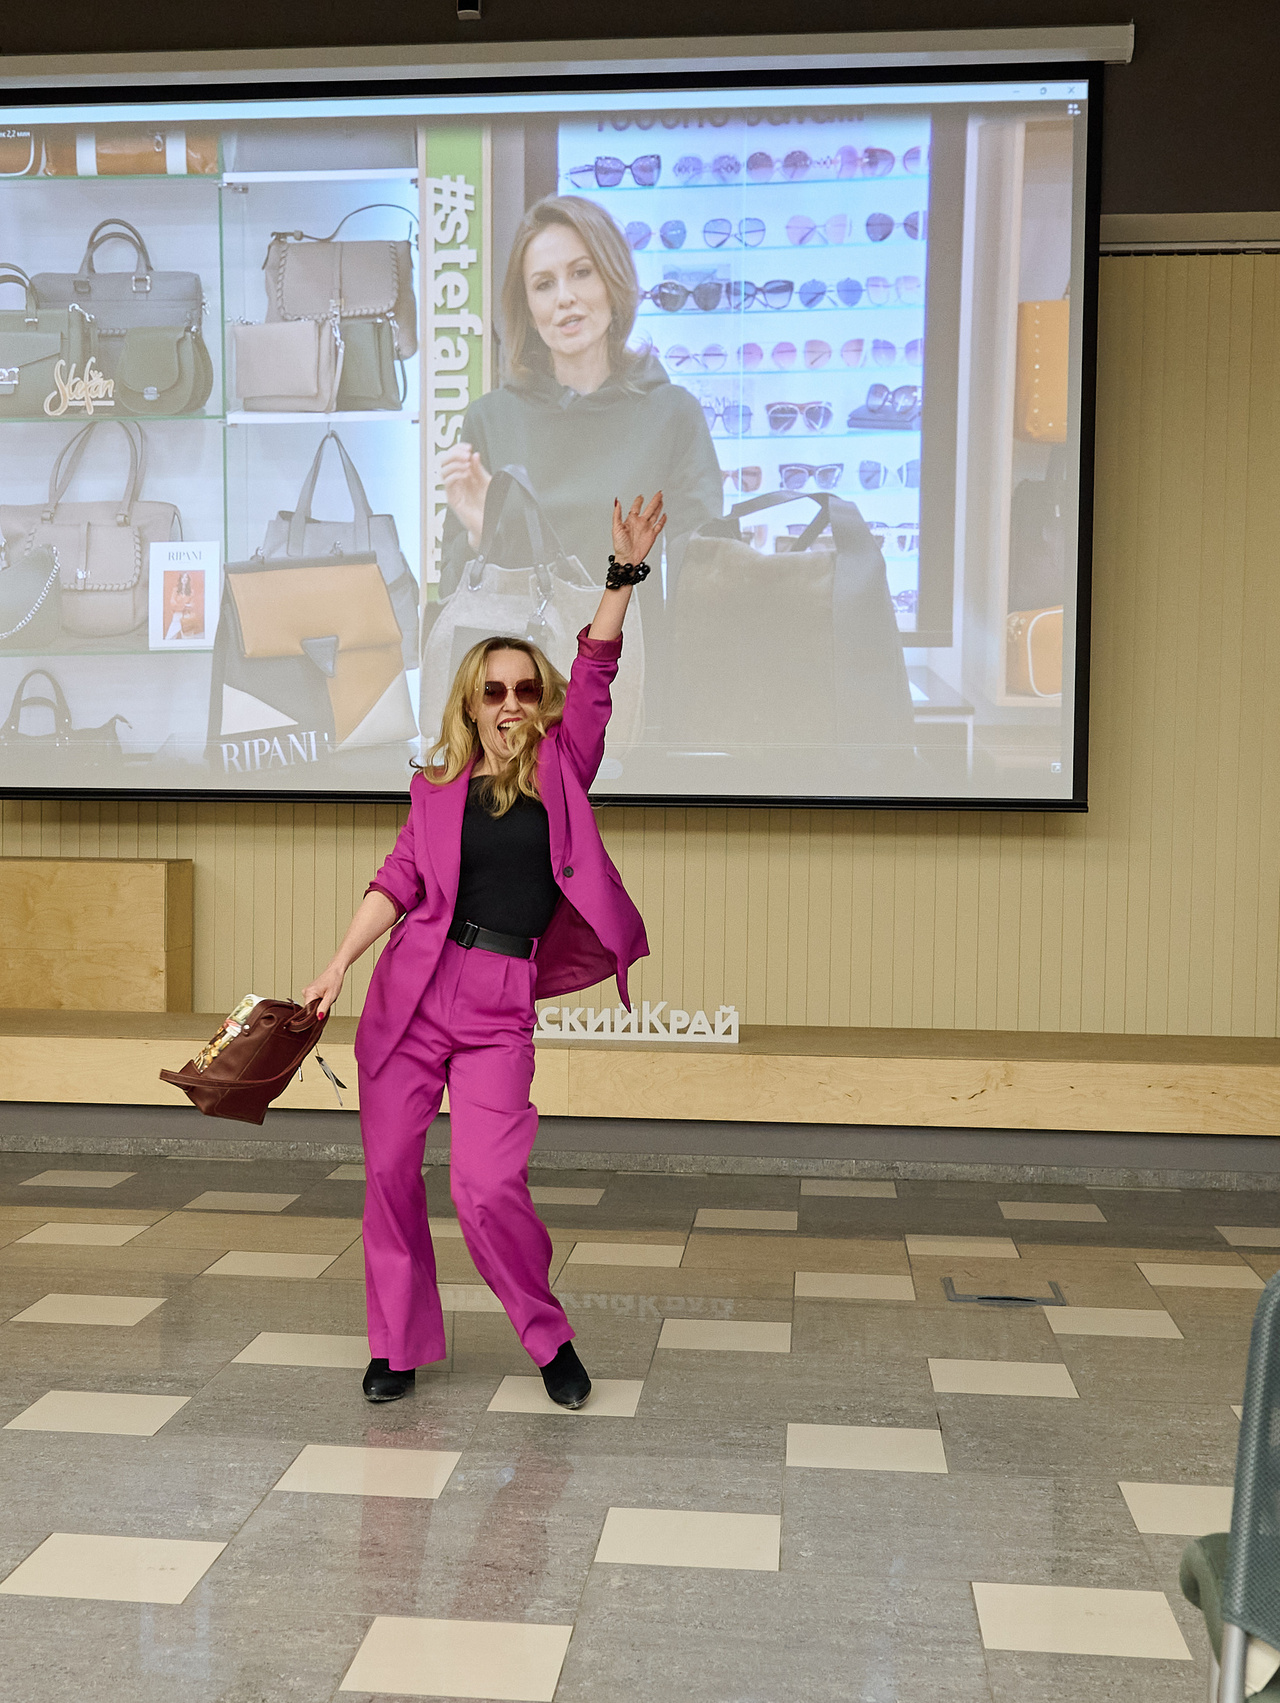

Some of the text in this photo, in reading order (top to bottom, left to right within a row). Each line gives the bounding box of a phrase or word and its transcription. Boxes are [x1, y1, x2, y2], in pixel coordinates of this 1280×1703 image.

[43, 356, 115, 416] Stefan
[168, 551, 202, 561] RIPANI
[220, 730, 319, 774] RIPANI
